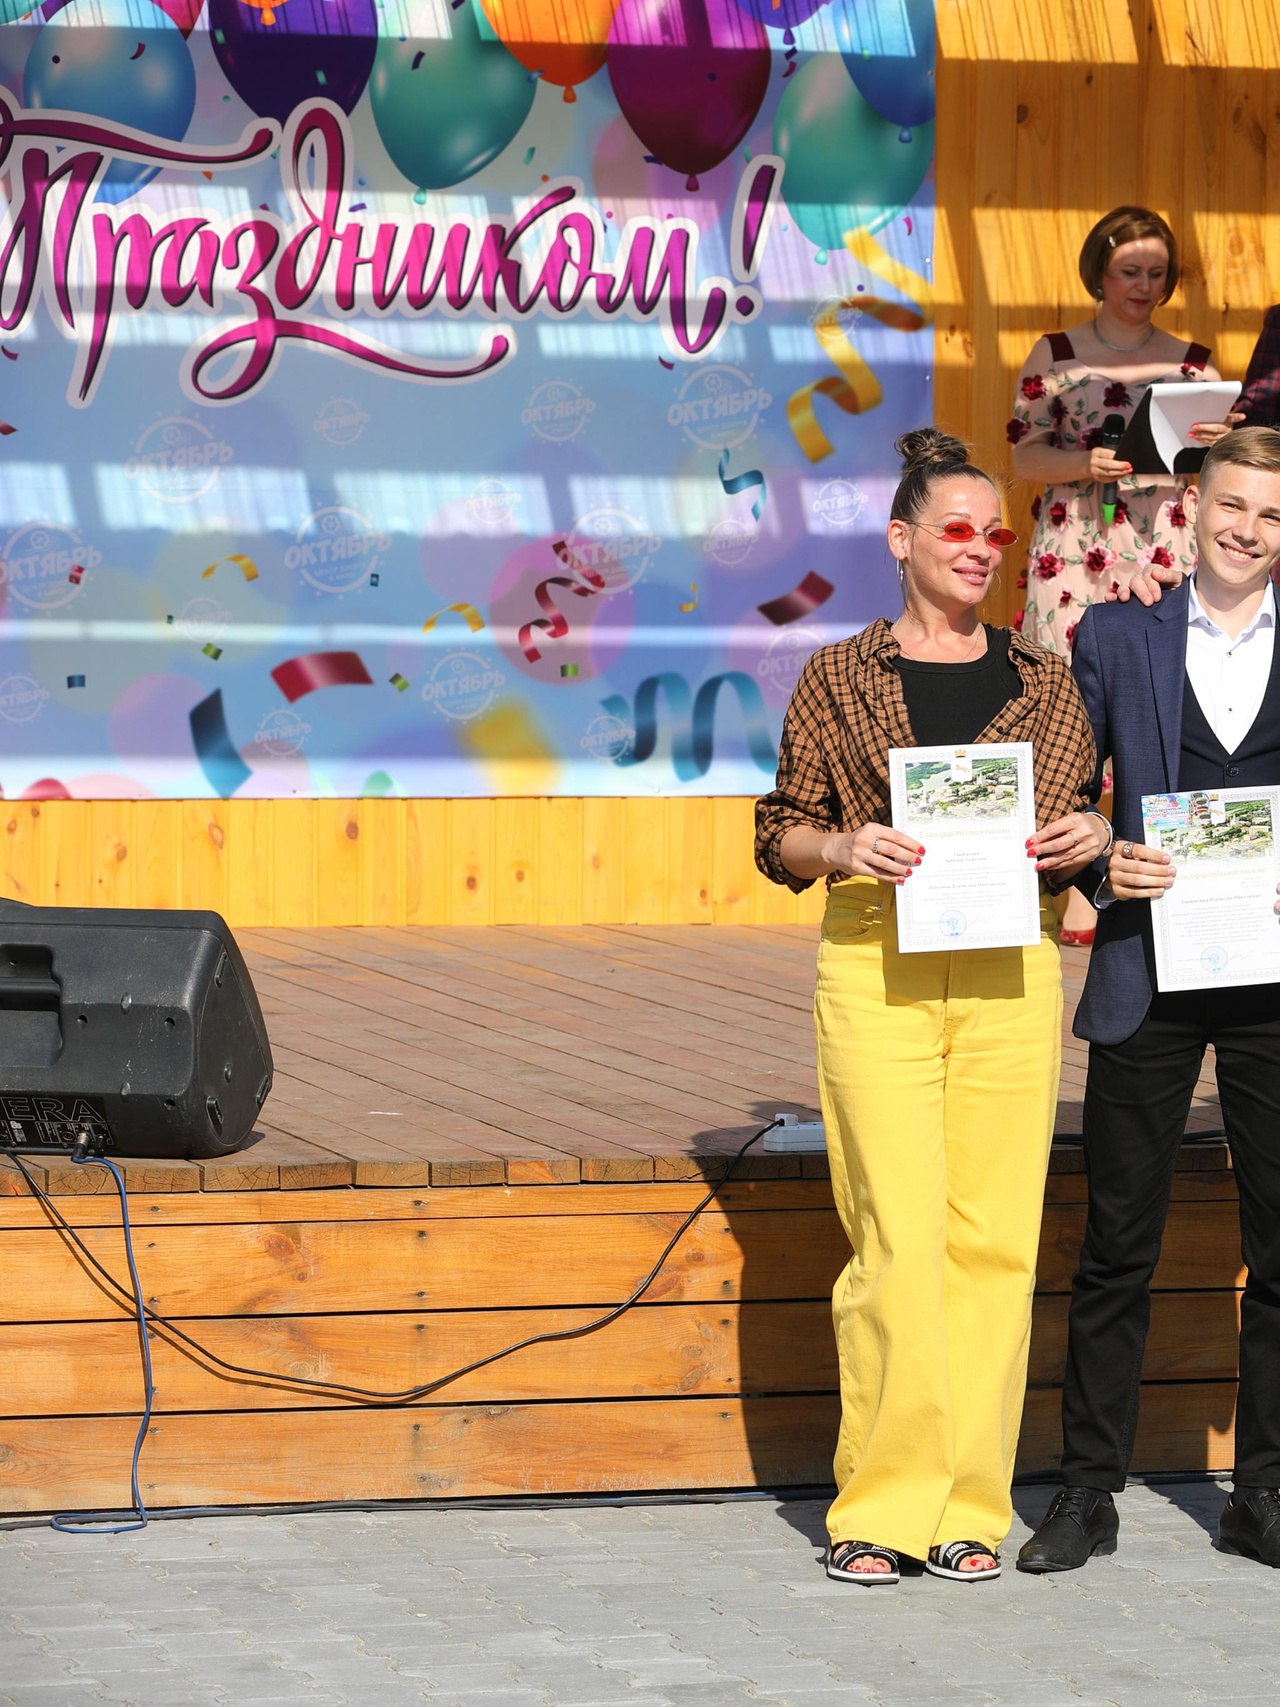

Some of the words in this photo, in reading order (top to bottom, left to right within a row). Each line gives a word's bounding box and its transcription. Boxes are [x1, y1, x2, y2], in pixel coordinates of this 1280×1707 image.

[0, 98, 779, 402] Праздником!
[521, 396, 597, 425] ОКТЯБРЬ
[666, 386, 773, 427] ОКТЯБРЬ
[124, 440, 234, 479] ОКТЯБРЬ
[812, 491, 869, 513] ОКТЯБРЬ
[284, 530, 393, 569] ОКТЯБРЬ
[556, 533, 663, 570] ОКТЯБРЬ
[757, 652, 806, 677] ОКТЯ
[0, 688, 50, 706] КТЯБРЬ
[421, 670, 506, 702] ОКТЯБРЬ
[255, 721, 312, 743] ОКТЯБРЬ
